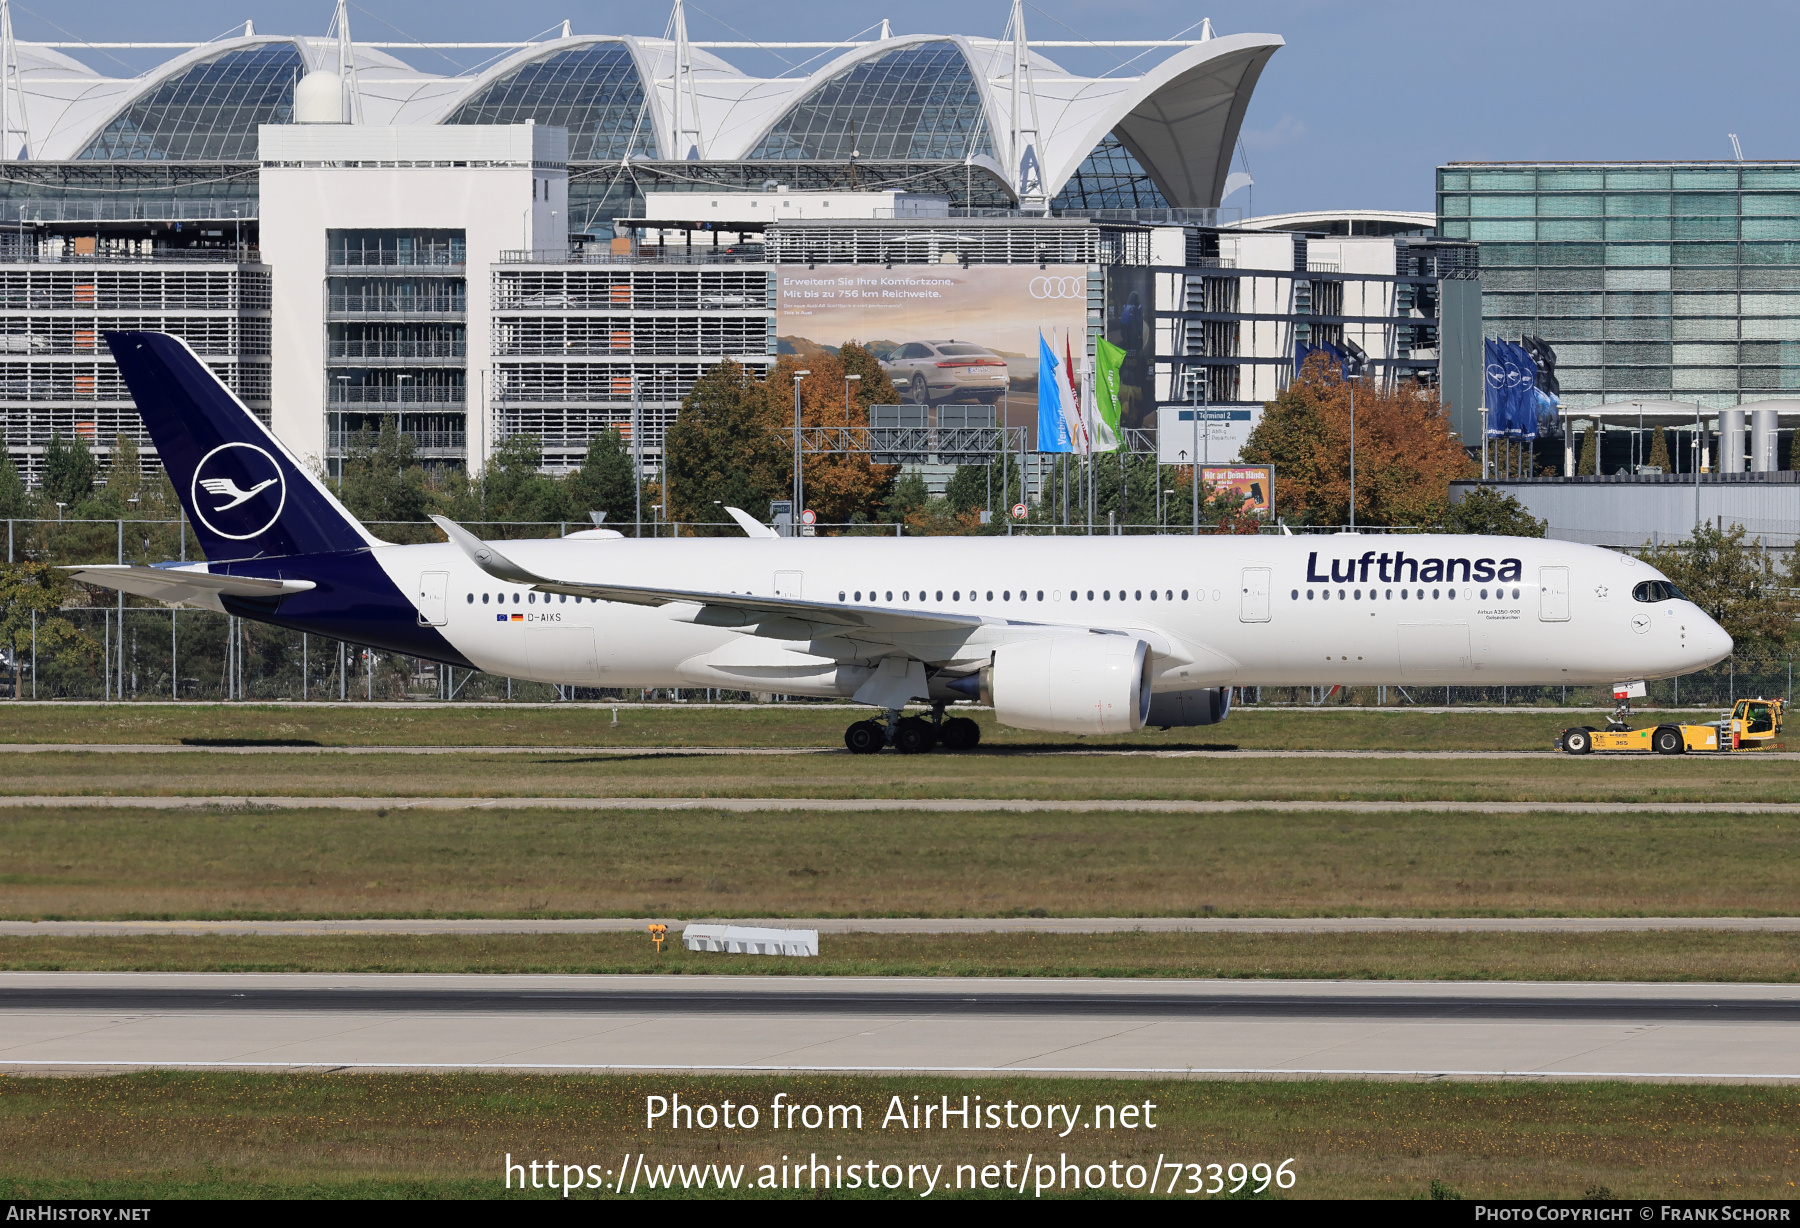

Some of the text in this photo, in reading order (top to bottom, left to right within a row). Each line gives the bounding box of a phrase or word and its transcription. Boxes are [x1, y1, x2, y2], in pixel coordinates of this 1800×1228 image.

[783, 277, 954, 286] Erweitern Sie Ihre Komfortzone.
[783, 290, 802, 298] Mit
[804, 290, 820, 298] bis
[838, 290, 859, 298] 756
[862, 290, 879, 298] km
[882, 290, 942, 298] Reichweite.
[1226, 411, 1231, 419] 2
[1216, 470, 1227, 479] auf
[1227, 470, 1245, 479] Deine
[1245, 470, 1267, 479] Hände.
[1307, 551, 1521, 584] Lufthansa
[527, 613, 562, 622] D-AIXS
